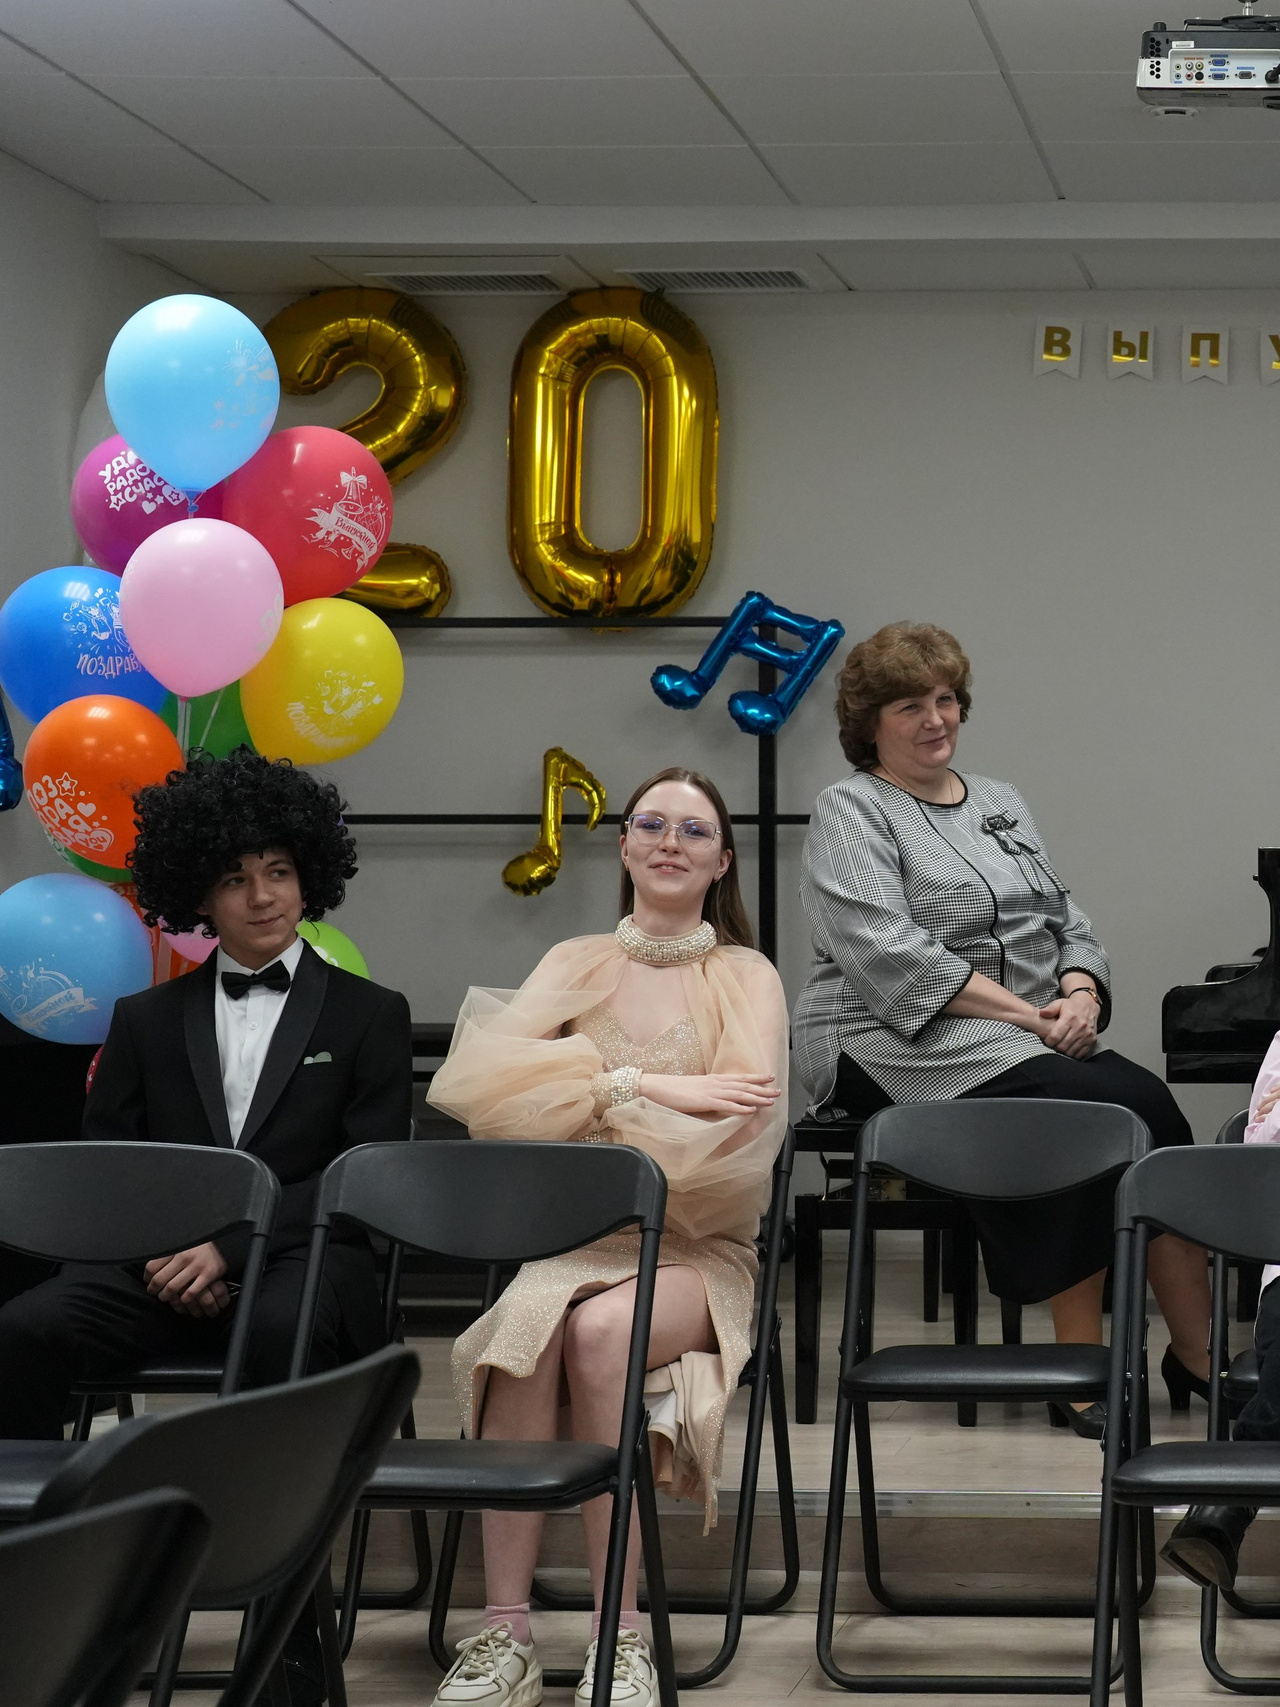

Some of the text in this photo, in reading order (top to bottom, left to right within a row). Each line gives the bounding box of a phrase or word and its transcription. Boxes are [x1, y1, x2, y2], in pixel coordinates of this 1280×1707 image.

[98, 450, 140, 484] УДА
[106, 463, 150, 495] РАДО
[124, 474, 165, 503] СЧАС
[335, 516, 376, 551] Выпускной
[76, 652, 142, 680] ПОЗДРАВ
